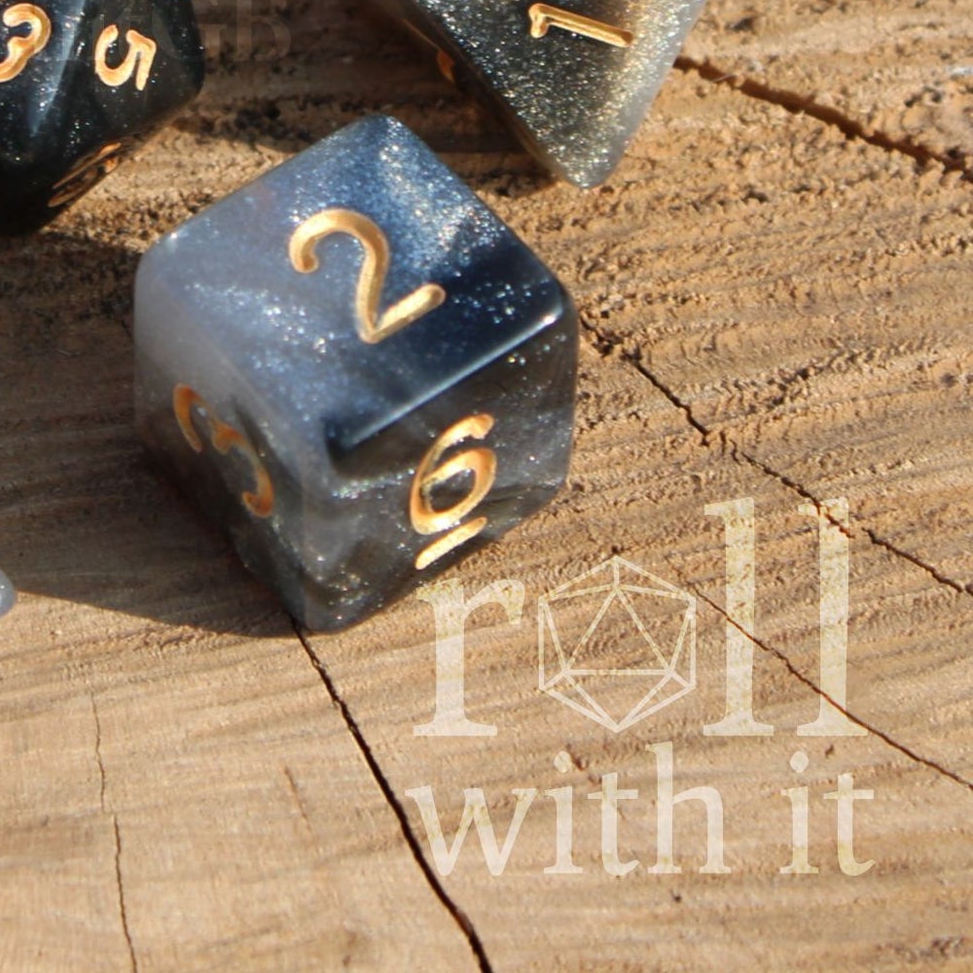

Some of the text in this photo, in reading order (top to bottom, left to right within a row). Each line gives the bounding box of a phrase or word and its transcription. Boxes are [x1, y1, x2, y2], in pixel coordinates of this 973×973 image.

[95, 24, 157, 90] 5
[289, 208, 447, 344] 2
[173, 384, 274, 518] 3
